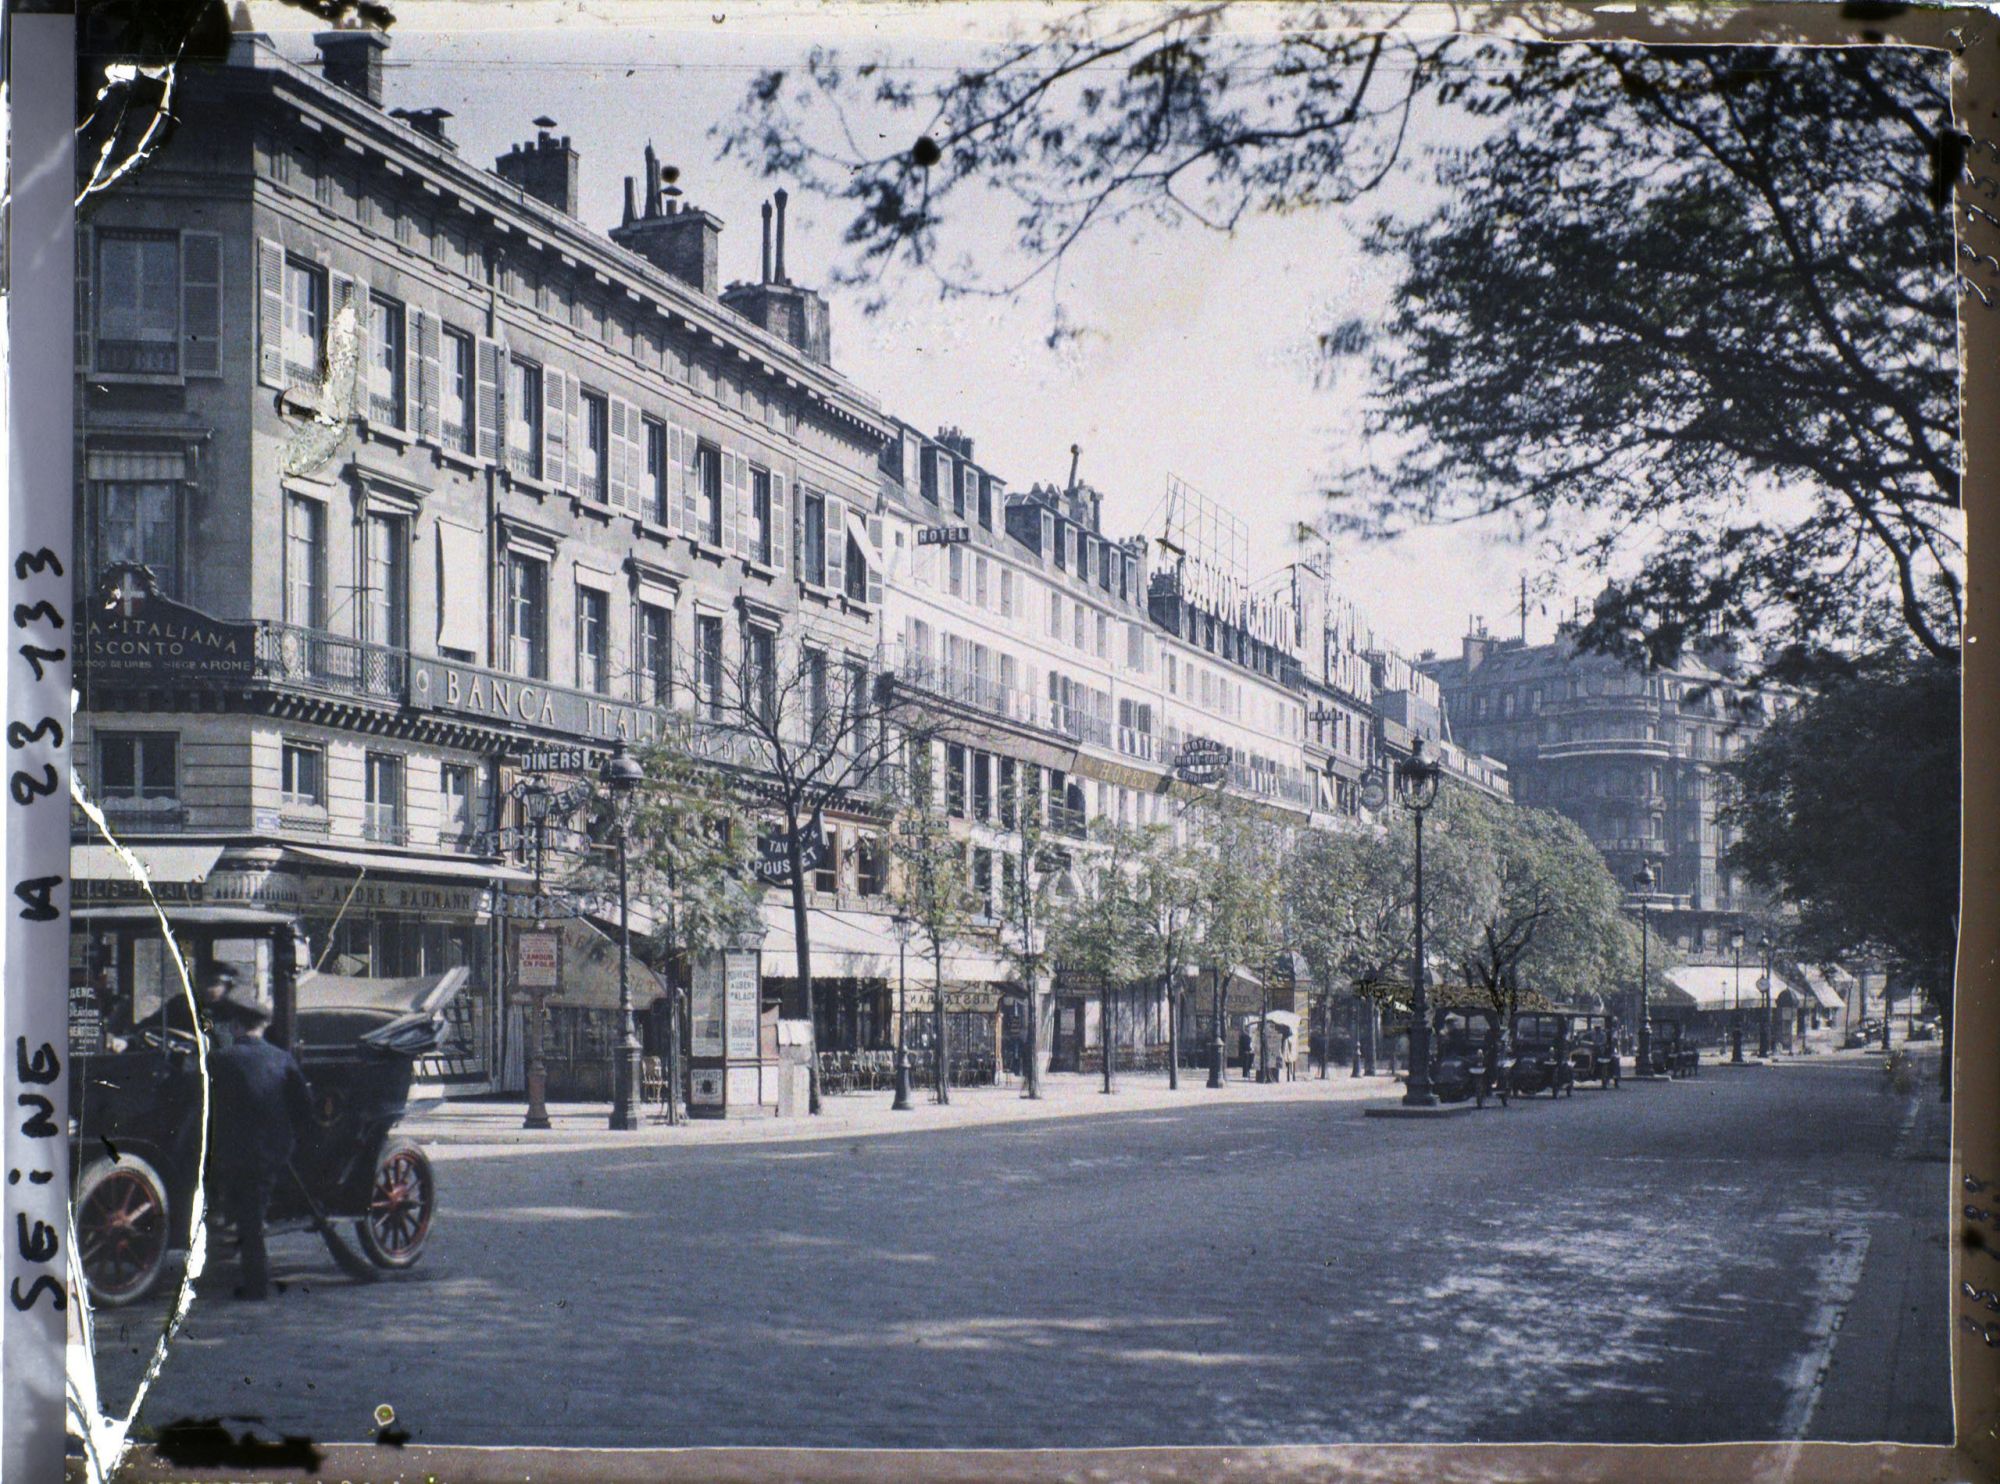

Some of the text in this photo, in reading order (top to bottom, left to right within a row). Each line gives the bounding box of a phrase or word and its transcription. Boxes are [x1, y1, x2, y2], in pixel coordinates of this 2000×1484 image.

[919, 527, 967, 543] HOTEL
[13, 547, 66, 682] 133
[95, 640, 184, 655] SCONTO
[122, 619, 237, 654] ITALIANA
[210, 659, 250, 671] ROME
[446, 669, 556, 727] BANCA
[585, 700, 713, 757] ITALIANA
[9, 716, 64, 806] 23
[521, 752, 581, 770] DINERS
[1100, 762, 1148, 788] HOTEL
[753, 846, 817, 876] POUSET
[15, 875, 64, 922] A
